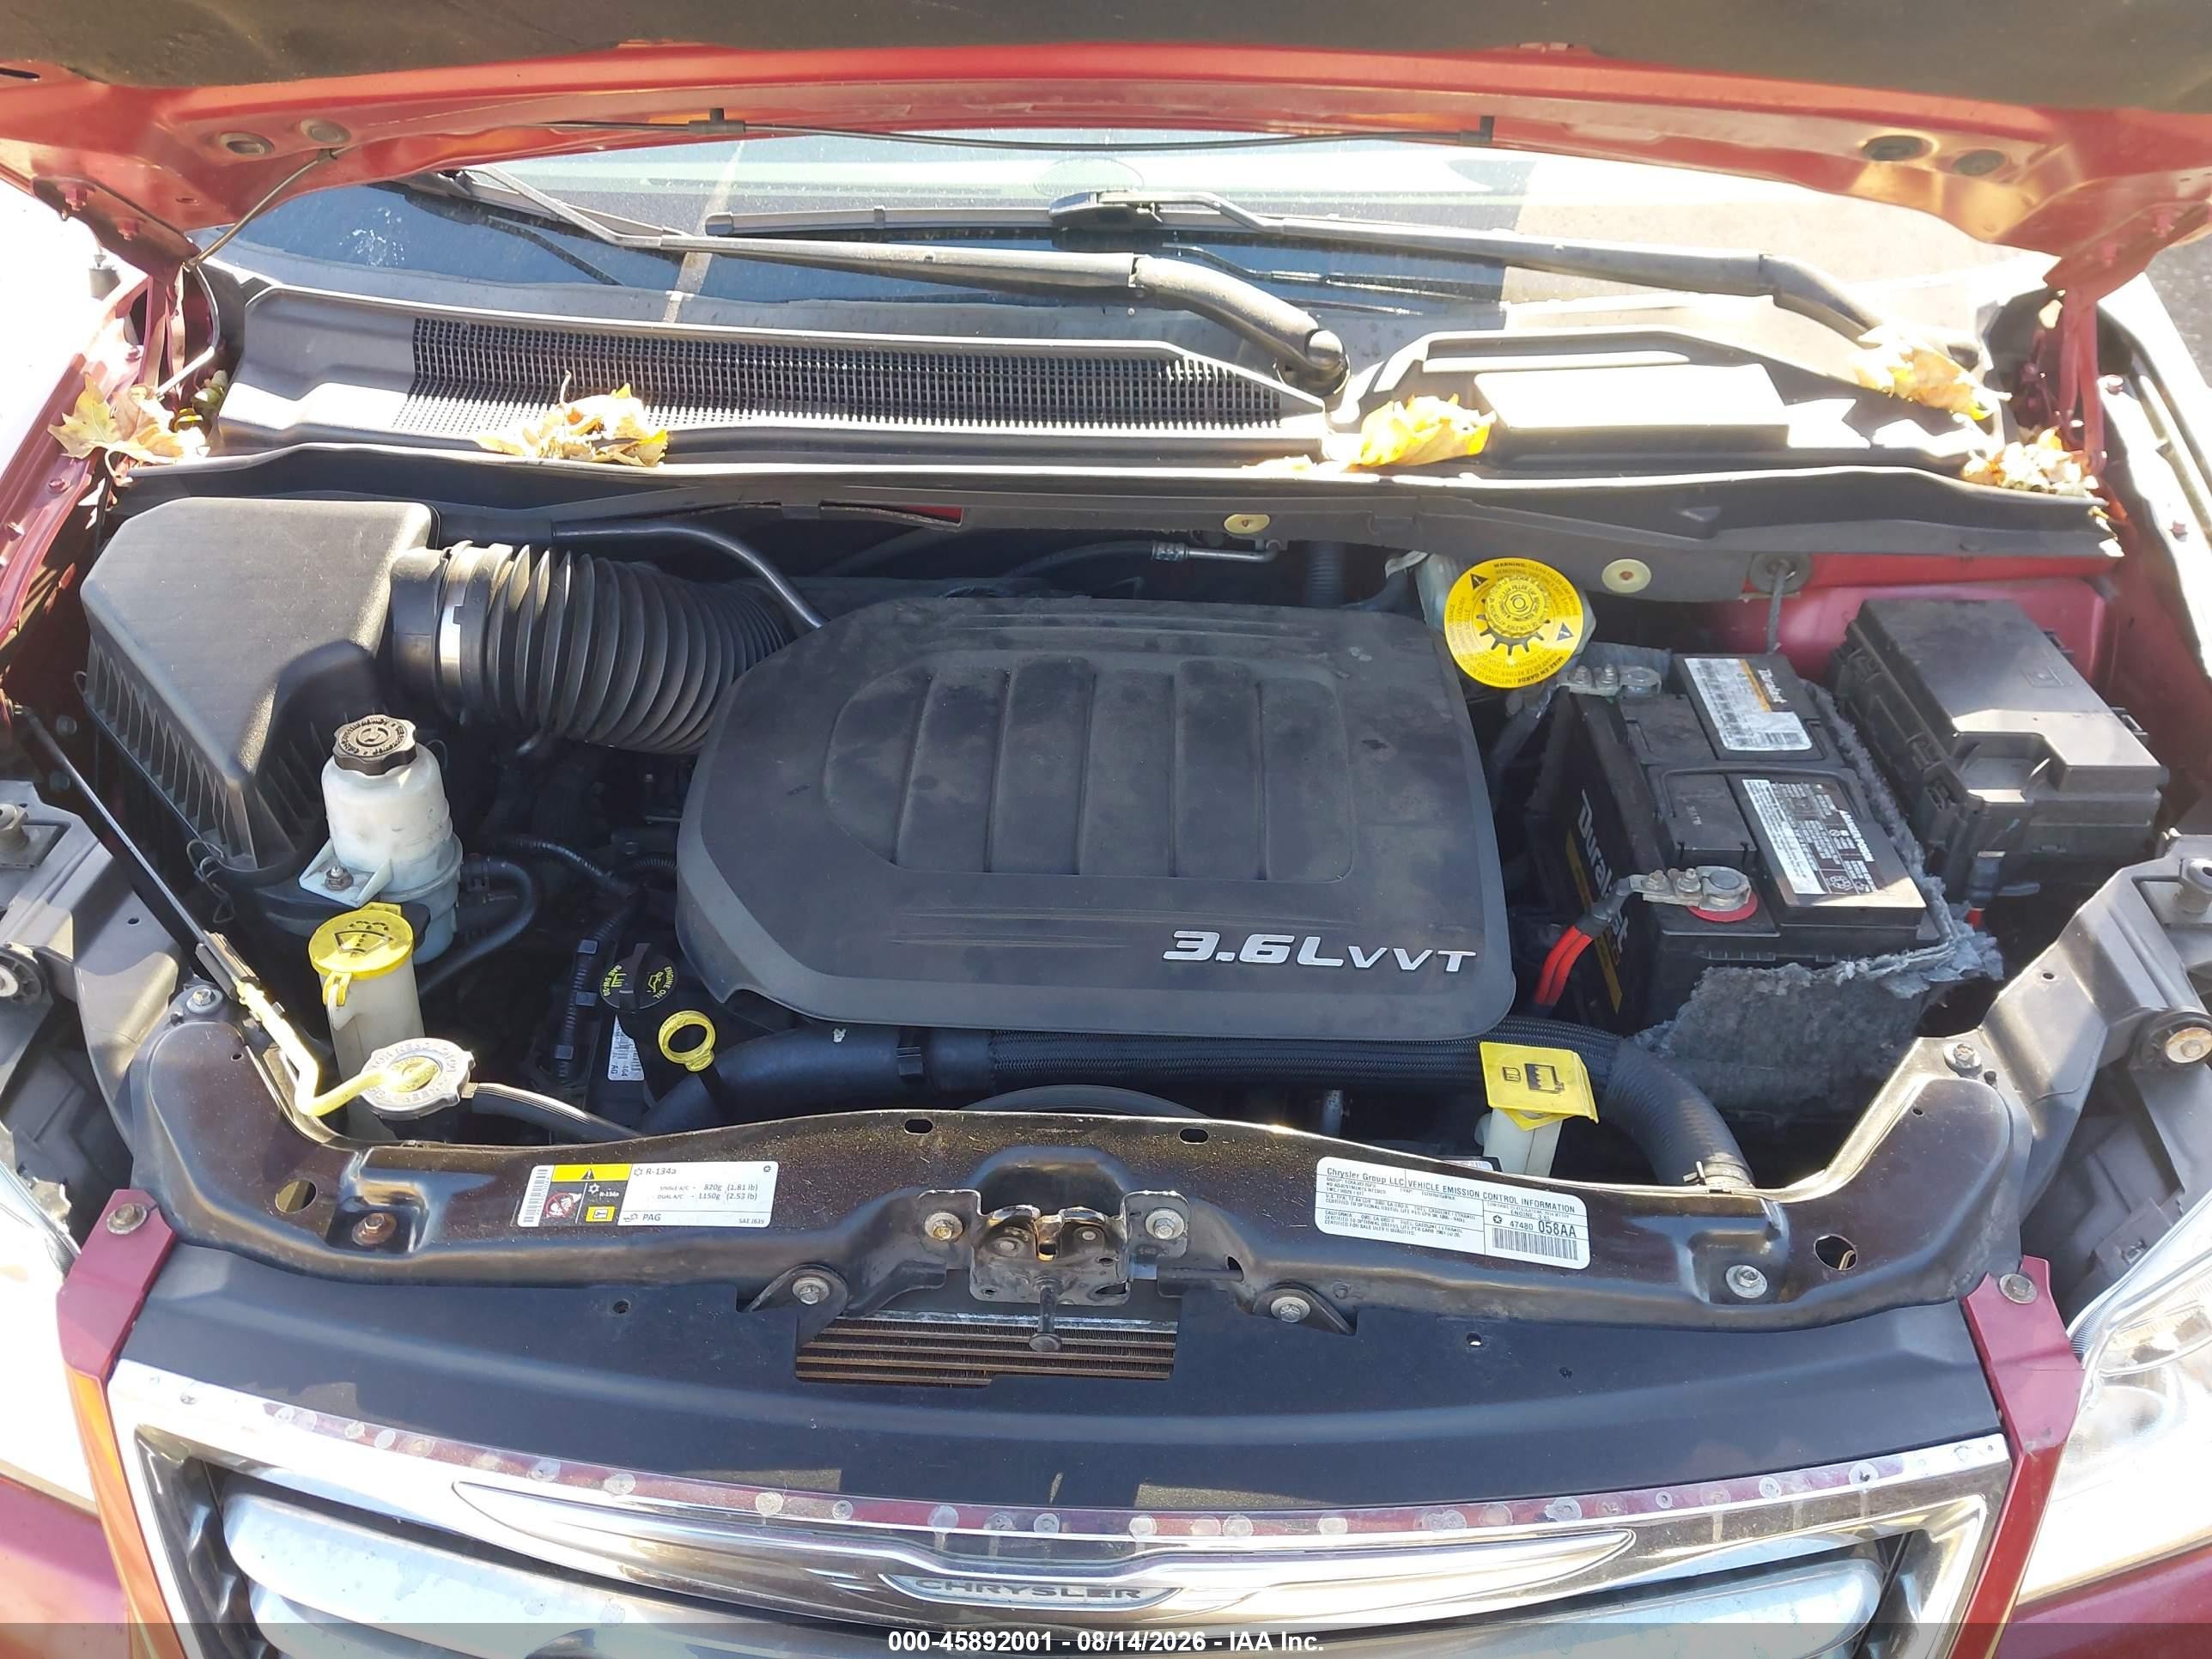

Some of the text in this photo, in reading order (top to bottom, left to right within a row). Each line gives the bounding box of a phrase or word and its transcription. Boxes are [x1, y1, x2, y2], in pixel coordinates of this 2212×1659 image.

[653, 966, 674, 999] ENGINE OIL
[726, 1183, 747, 1192] (1.81
[746, 1192, 757, 1200] lb)
[1327, 1168, 1359, 1179] Chrysler
[1363, 1173, 1386, 1184] Group
[1389, 1177, 1404, 1186] LLC
[1408, 1180, 1439, 1191] VEHICLE
[1443, 1185, 1480, 1198] EMISSION
[1483, 1191, 1518, 1204] CONTROL
[1522, 1199, 1575, 1213] INFORMATION
[1510, 1220, 1577, 1238] 47480 058AA
[915, 1578, 1141, 1599] CHRYSLER
